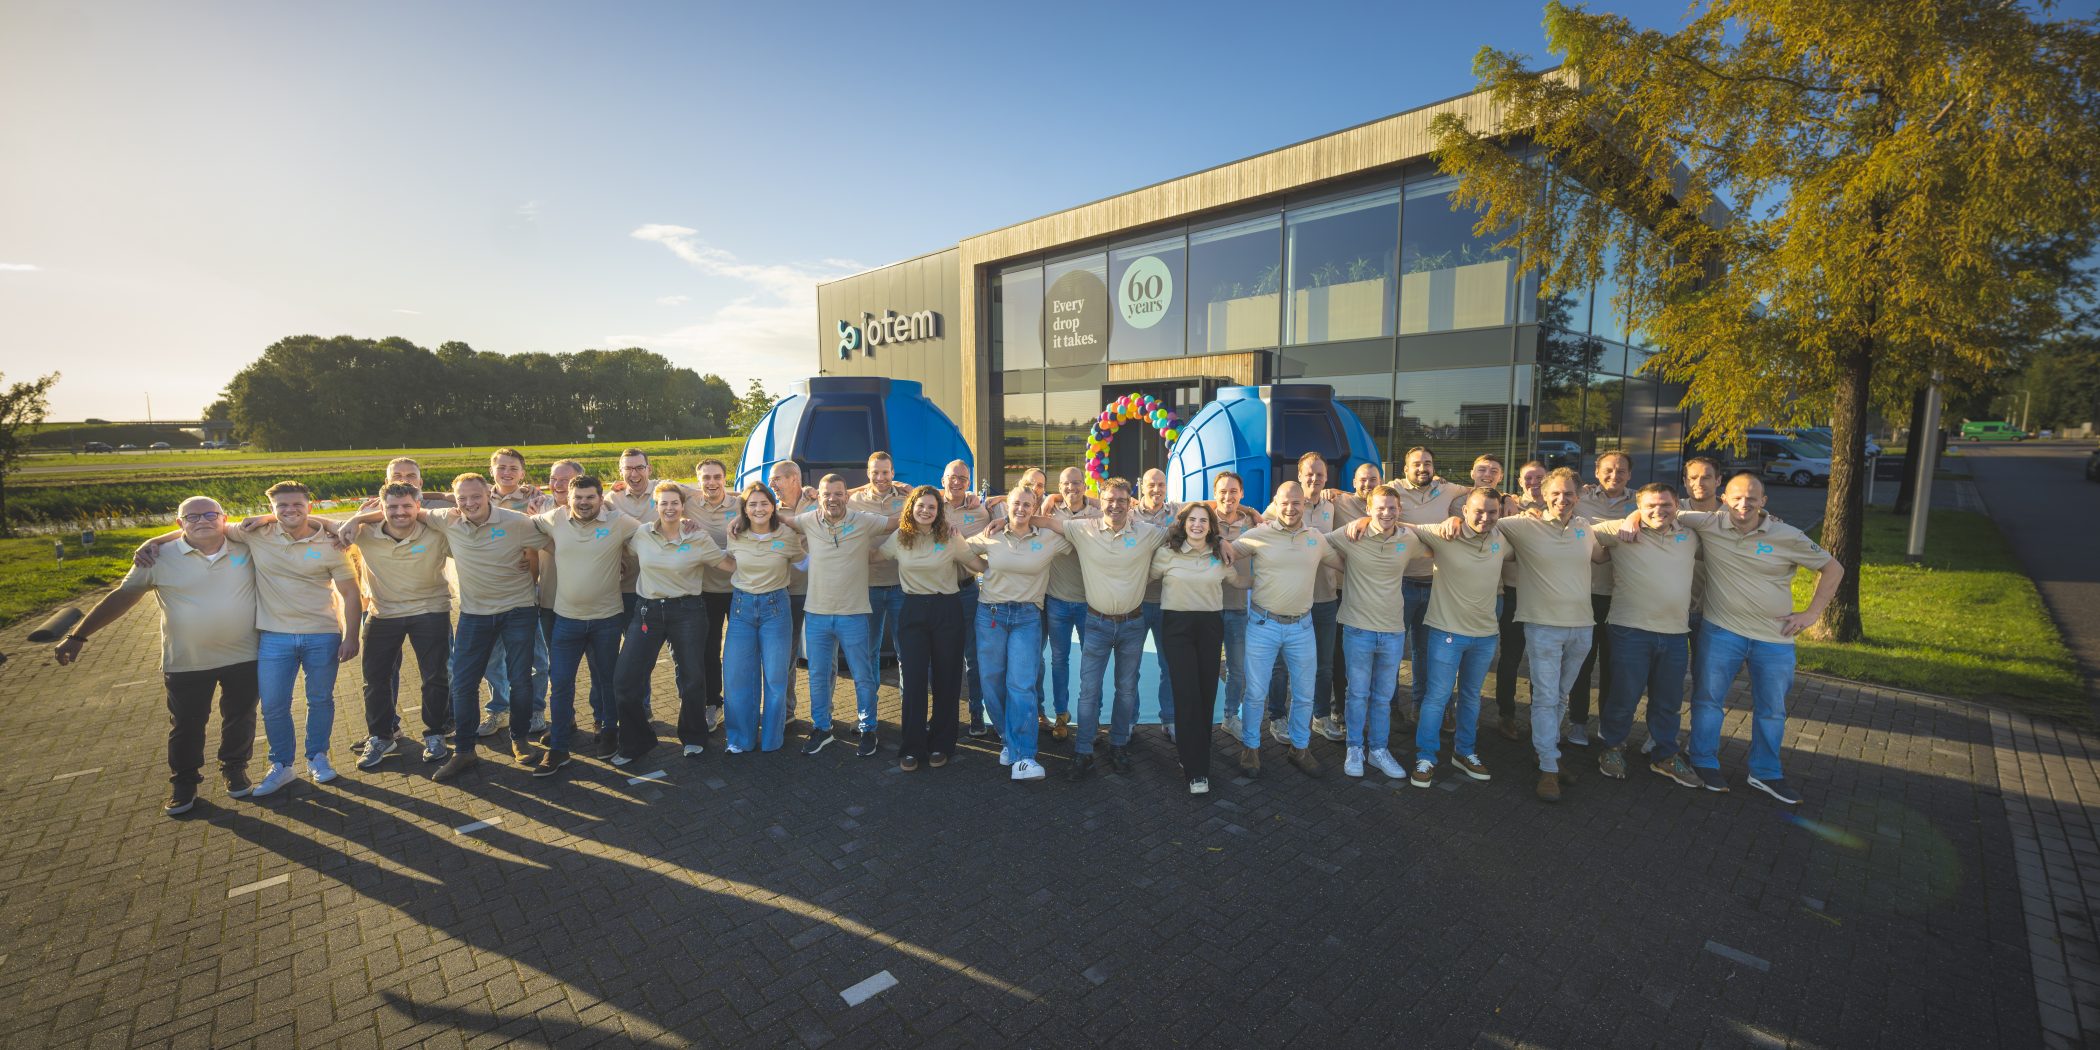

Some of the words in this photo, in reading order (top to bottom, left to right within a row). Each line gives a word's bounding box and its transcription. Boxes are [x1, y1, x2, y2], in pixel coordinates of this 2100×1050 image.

[1128, 269, 1163, 302] 60
[1053, 299, 1085, 314] Every
[1128, 300, 1163, 319] years
[860, 308, 935, 357] jotem
[1053, 317, 1080, 332] drop
[1053, 335, 1062, 348] it
[1064, 333, 1097, 347] takes.
